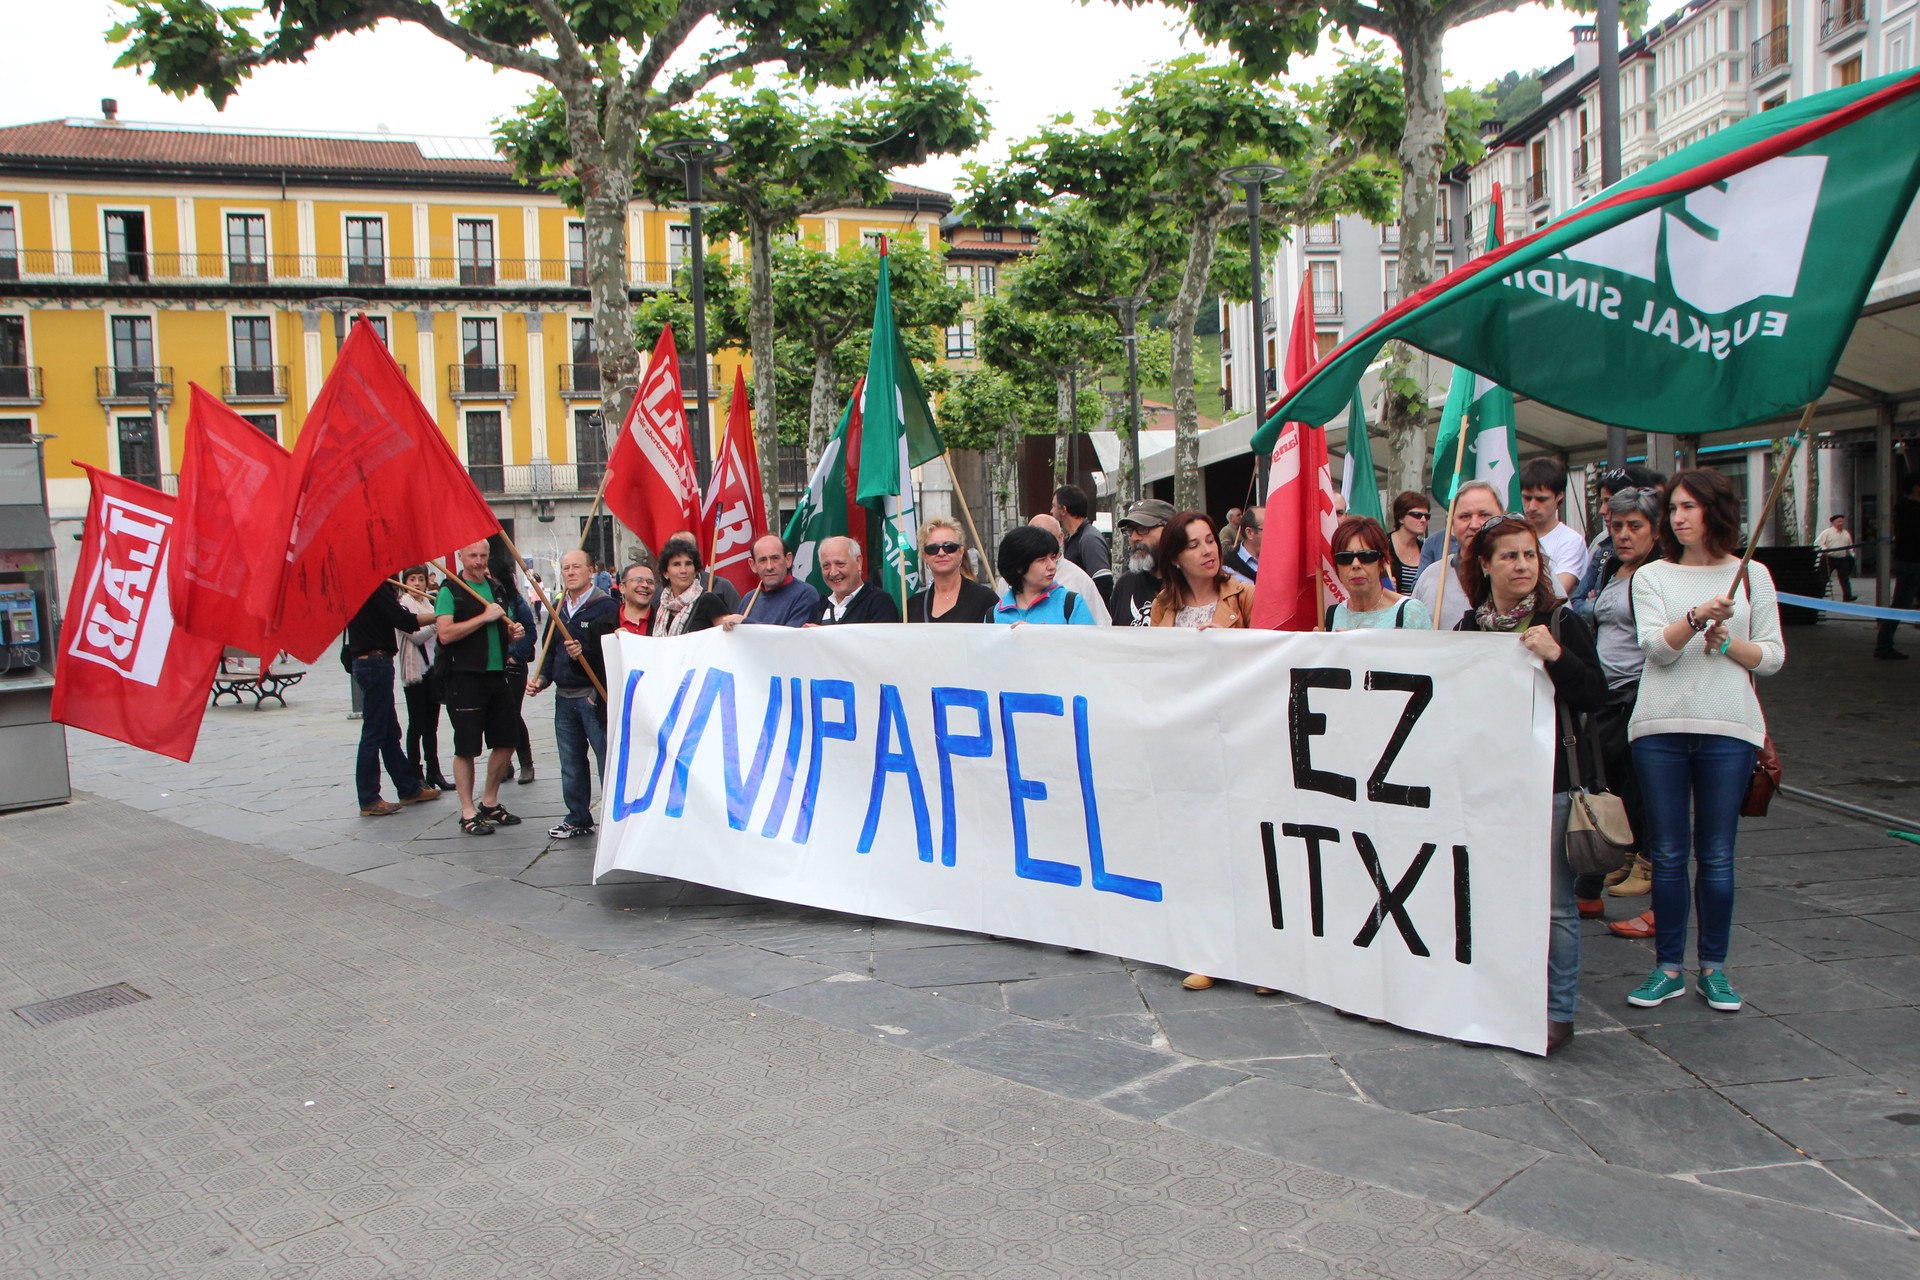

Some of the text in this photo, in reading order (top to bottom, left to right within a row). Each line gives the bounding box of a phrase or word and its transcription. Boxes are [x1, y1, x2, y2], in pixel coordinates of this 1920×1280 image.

[612, 668, 1163, 903] UNIPAPEL
[1289, 666, 1433, 809] EZ
[1260, 820, 1472, 966] ITXI
